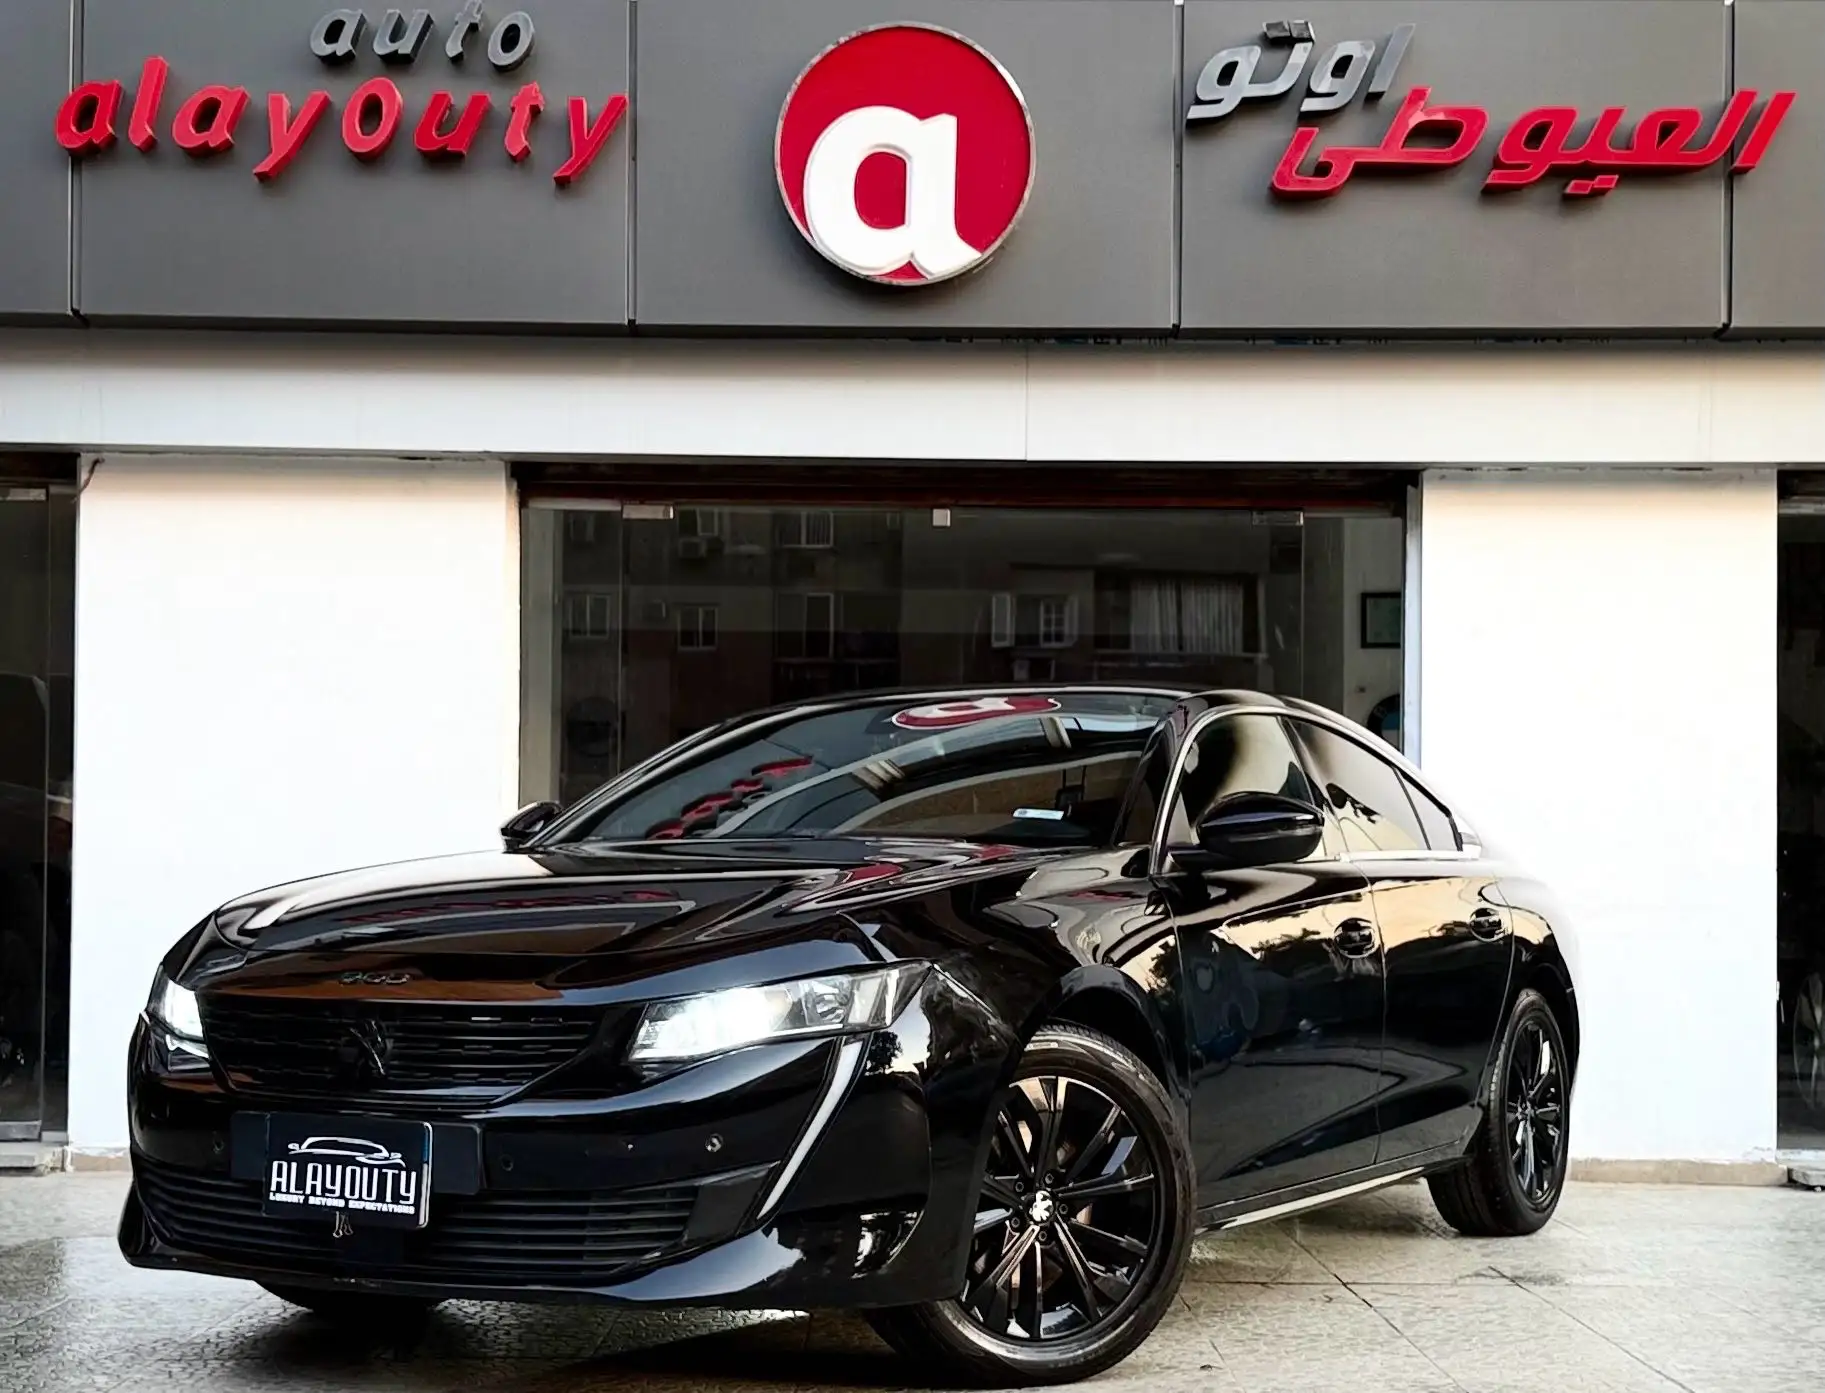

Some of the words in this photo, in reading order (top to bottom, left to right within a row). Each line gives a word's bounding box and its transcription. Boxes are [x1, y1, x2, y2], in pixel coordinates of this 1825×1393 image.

[310, 0, 535, 70] auto
[55, 55, 629, 186] alayouty
[803, 105, 982, 280] a
[270, 1160, 417, 1204] ALAYOUTY
